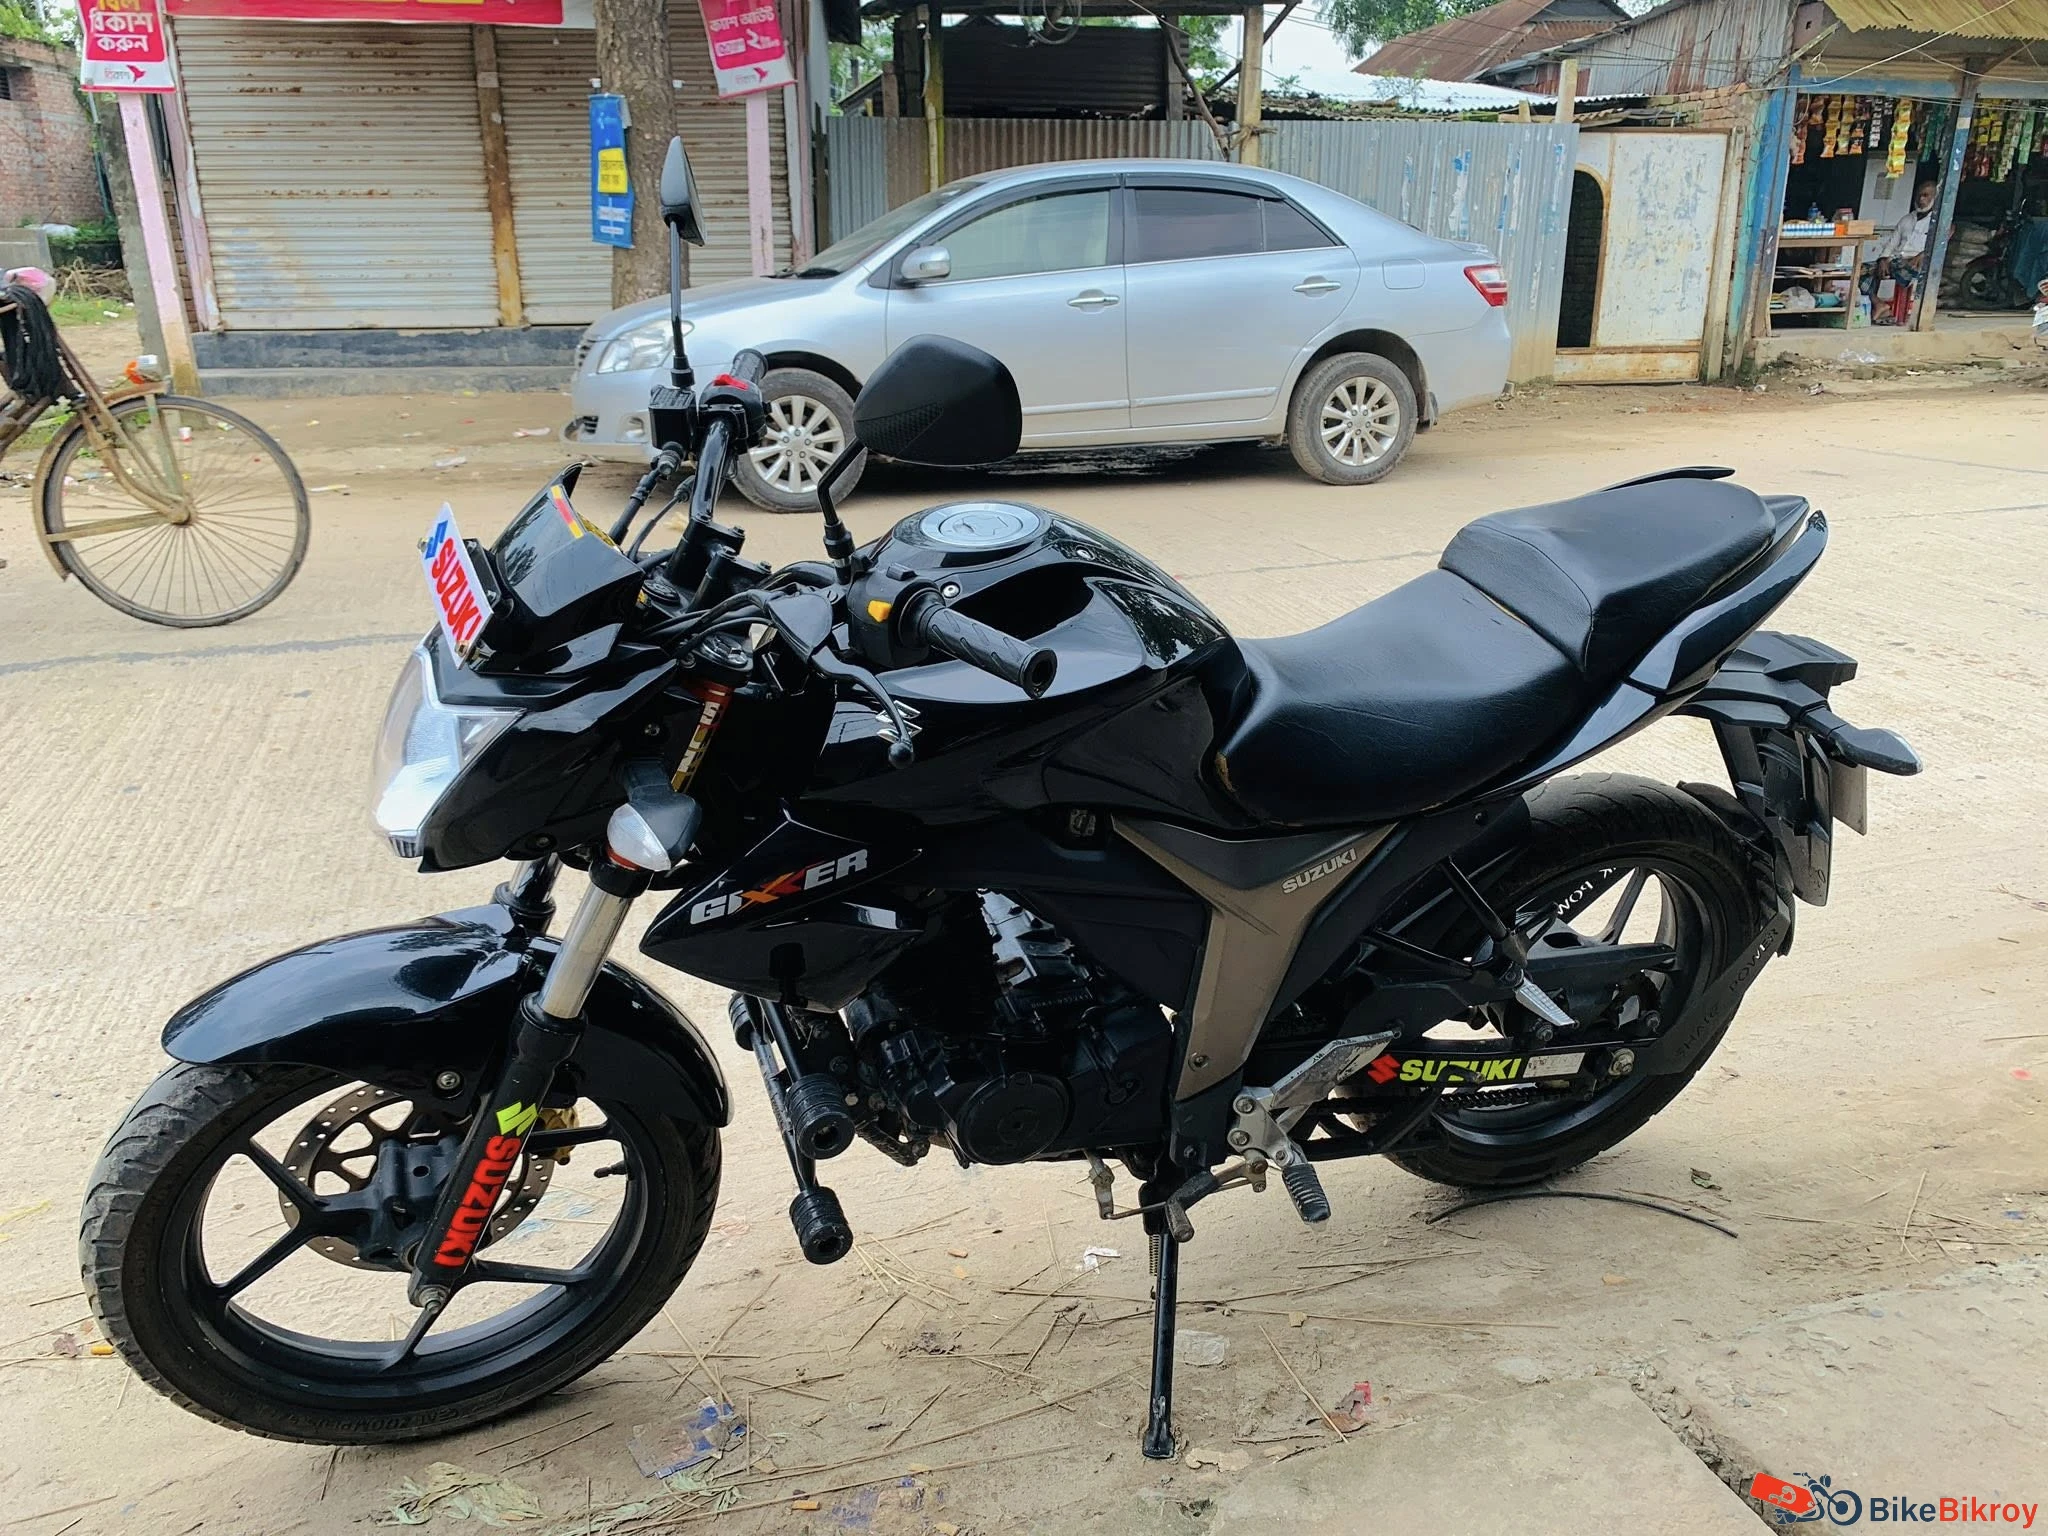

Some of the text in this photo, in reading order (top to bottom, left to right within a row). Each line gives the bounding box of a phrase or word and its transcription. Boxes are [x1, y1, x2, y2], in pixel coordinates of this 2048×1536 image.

[89, 7, 154, 33] বিকাশ
[94, 33, 149, 52] করুন
[431, 536, 483, 643] SUZUKI
[1281, 847, 1358, 895] SUZUKI
[1400, 1058, 1522, 1082] SUZUKI
[432, 1134, 522, 1269] SUZUKI
